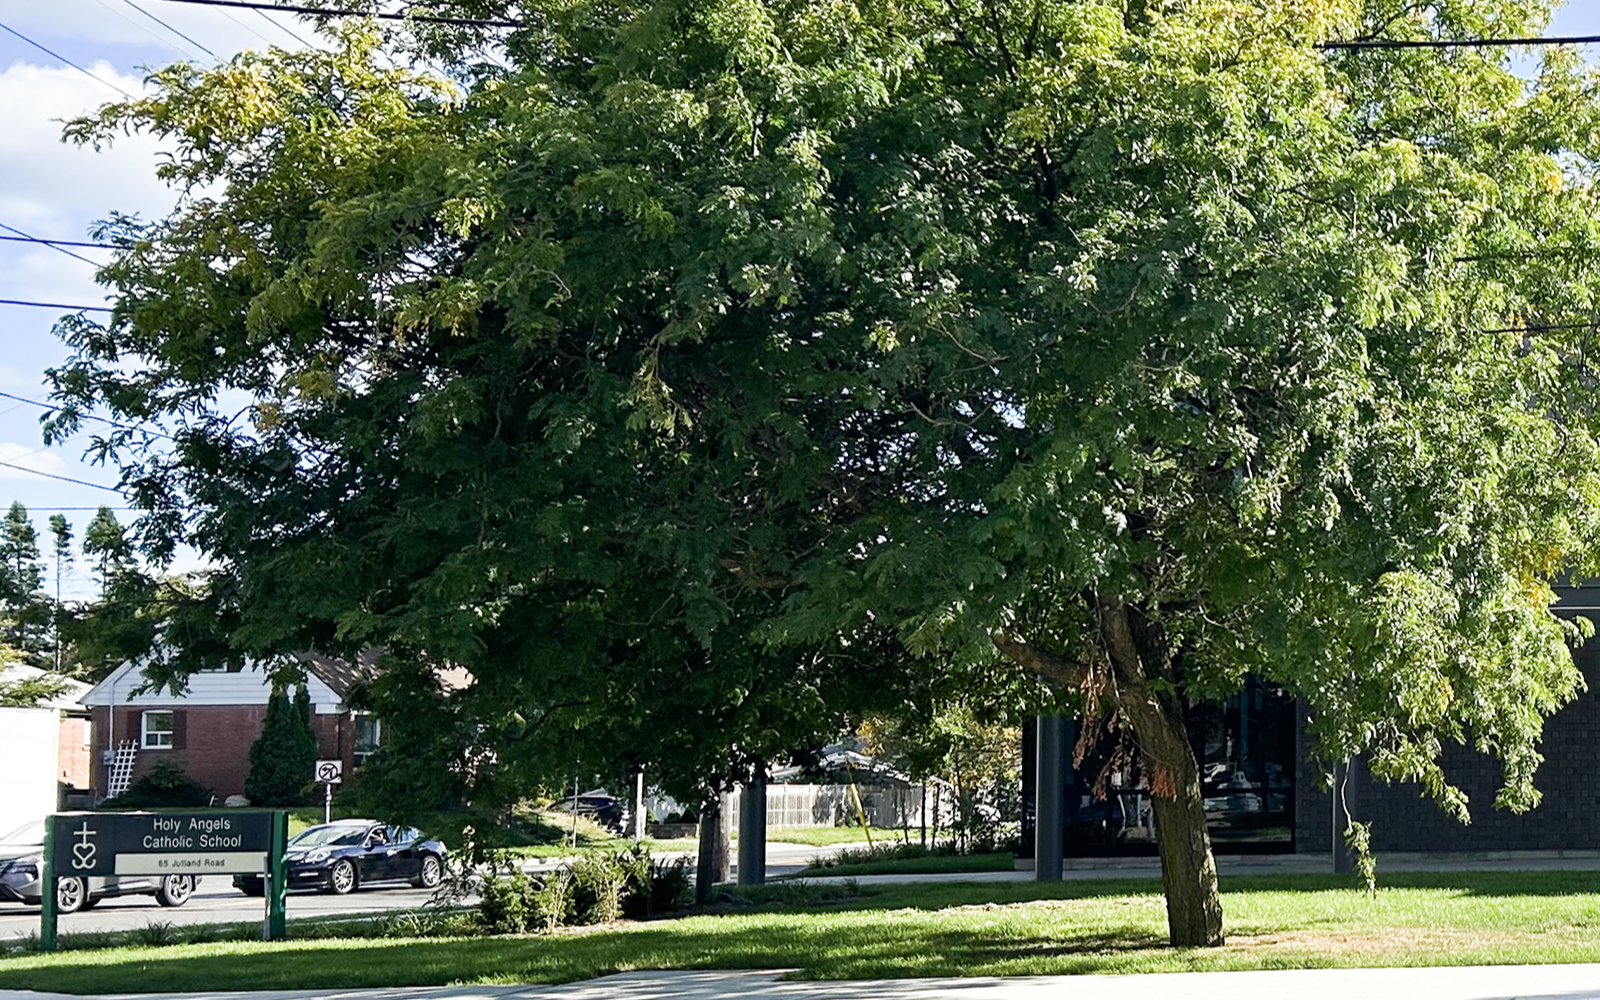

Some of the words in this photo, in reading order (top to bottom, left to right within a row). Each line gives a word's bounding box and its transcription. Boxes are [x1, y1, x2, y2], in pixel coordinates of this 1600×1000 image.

[153, 818, 181, 834] Holy
[188, 817, 231, 833] Angels
[143, 835, 193, 848] Catholic
[199, 834, 242, 848] School
[172, 860, 202, 868] Jutland
[204, 859, 225, 867] Road
